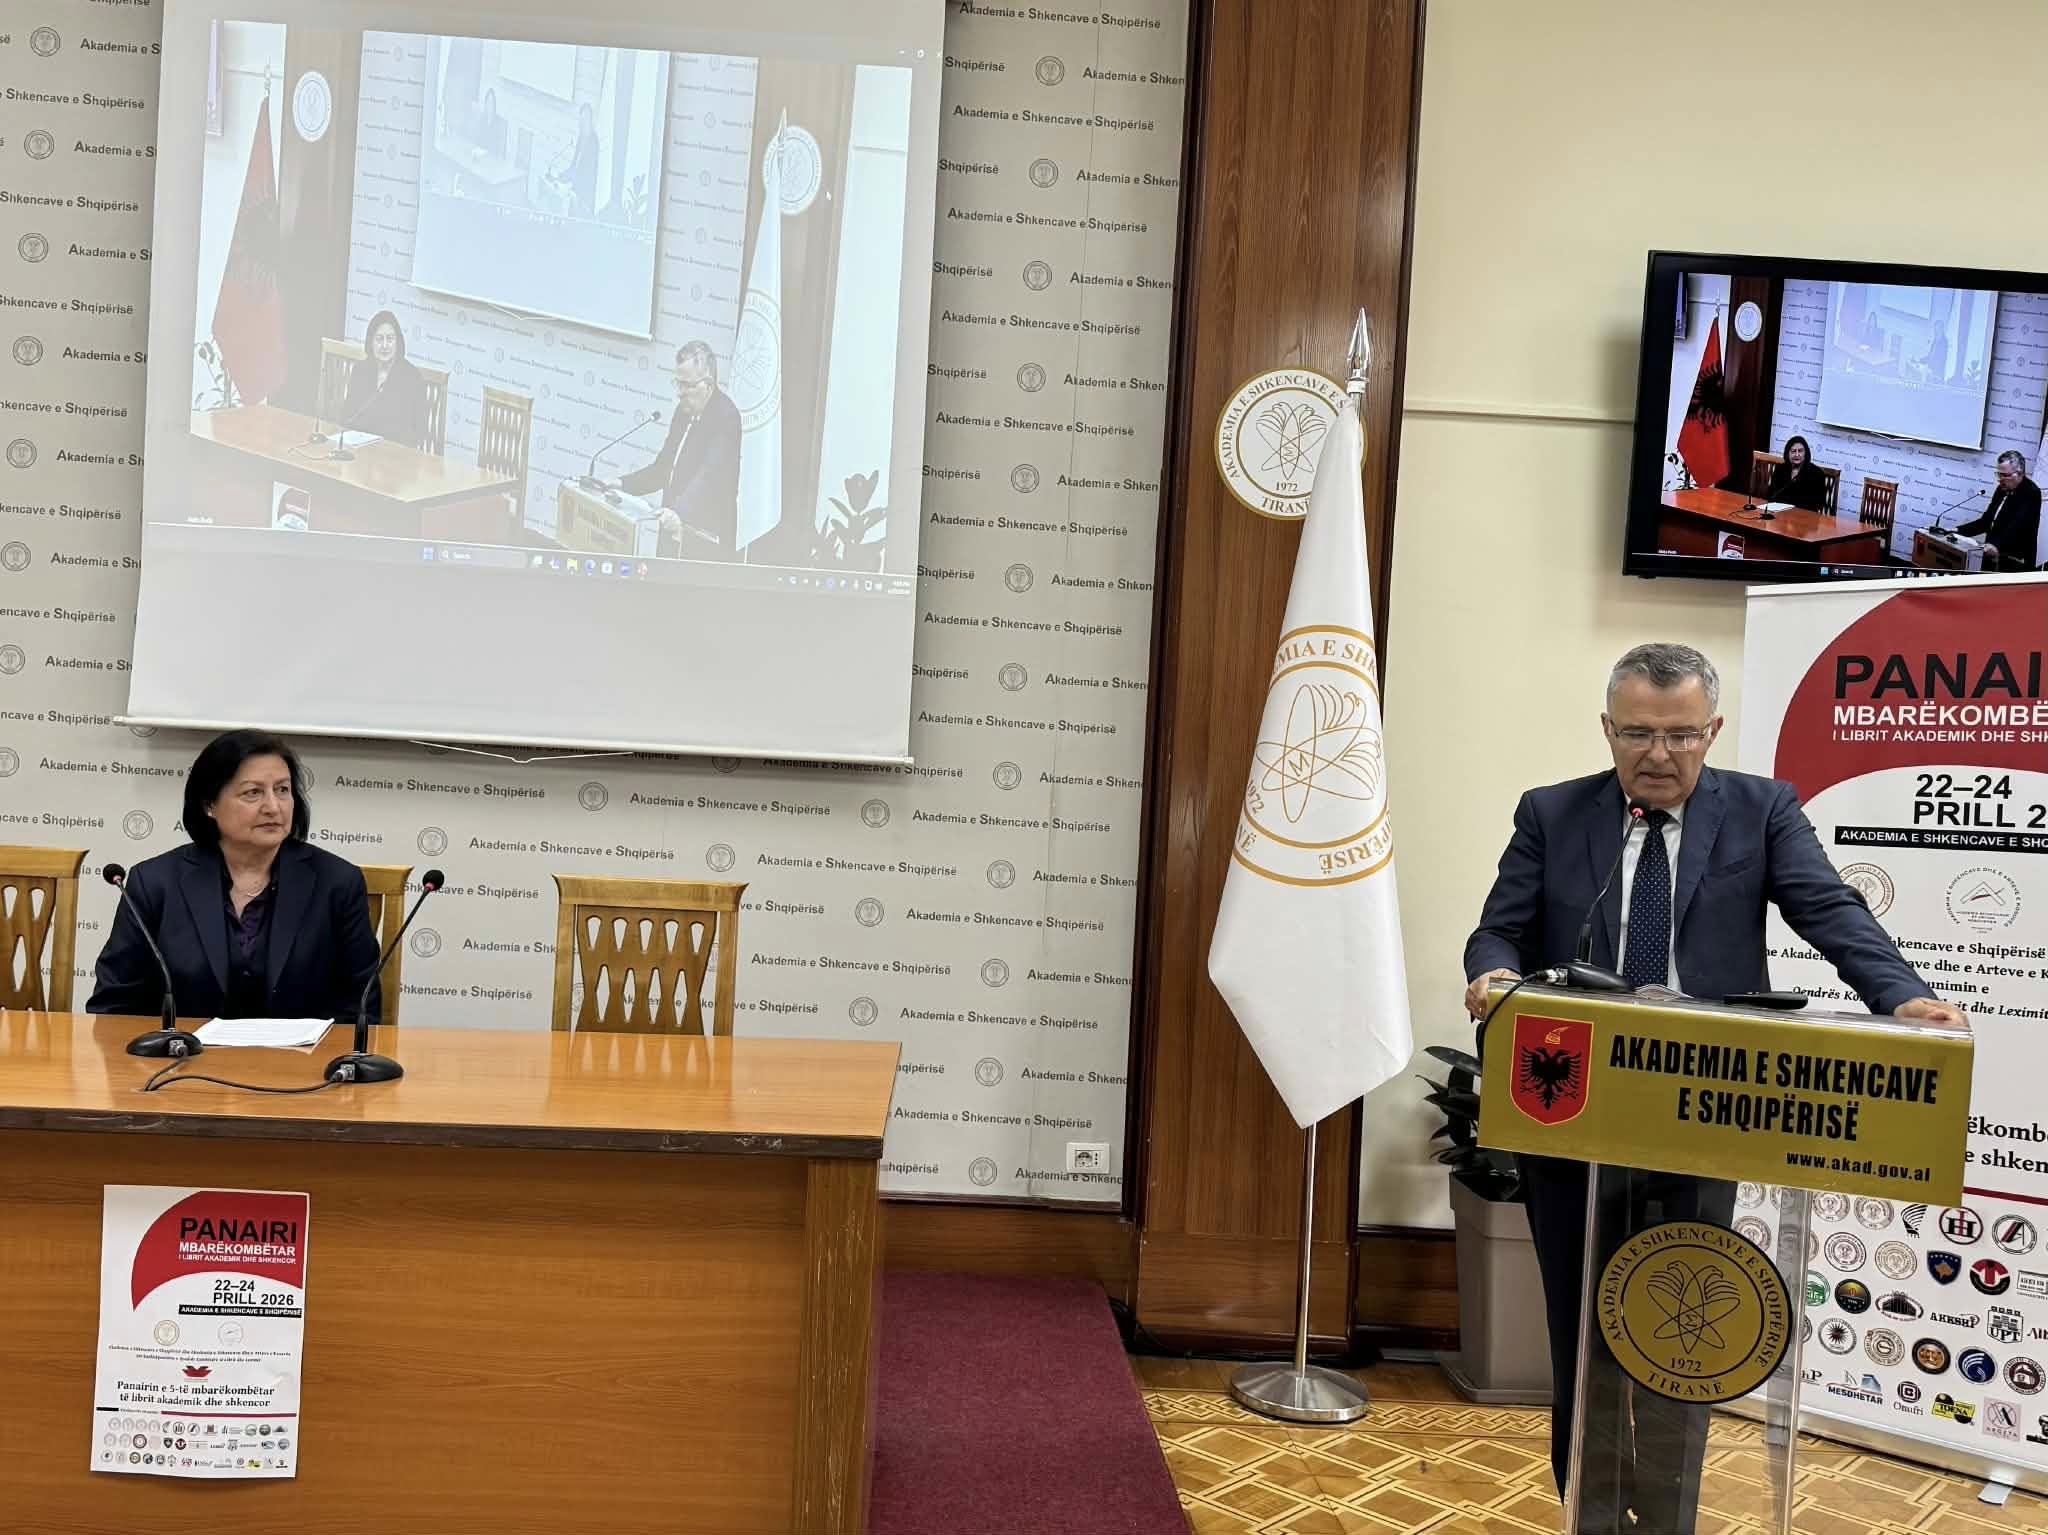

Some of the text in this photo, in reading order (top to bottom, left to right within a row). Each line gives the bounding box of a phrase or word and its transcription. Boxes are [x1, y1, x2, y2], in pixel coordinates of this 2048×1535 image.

[959, 1, 1016, 20] Akademia
[1028, 7, 1090, 24] Shkencave
[1100, 13, 1161, 29] Shqipërisë
[79, 37, 138, 54] Akademia
[945, 56, 1005, 74] Shqipërisë
[1082, 66, 1137, 82] Akademia
[1149, 71, 1185, 86] Shken
[5, 87, 70, 104] Shkencave
[82, 93, 145, 109] Shqipërisë
[952, 104, 1010, 120] Akademia
[1021, 109, 1083, 126] Shkencave
[1094, 115, 1154, 132] Shqipërisë
[73, 140, 133, 157] Akademia
[76, 195, 139, 212] Shqipërisë
[947, 207, 1003, 223] Akademia
[1015, 212, 1077, 228] Shkencave
[1087, 216, 1148, 233] Shqipërisë
[70, 299, 134, 315] Shqipërisë
[62, 346, 121, 362] Akademia
[1248, 375, 1327, 399] SHKENCAVE
[1275, 481, 1298, 492] 1972
[50, 551, 109, 567] Akademia
[923, 611, 979, 627] Akademia
[991, 616, 1052, 633] Shkencave
[1063, 620, 1123, 636] Shqipërisë
[1841, 729, 1889, 741] LIBRIT
[1892, 730, 1977, 742] AKADEMIK
[1981, 730, 2015, 743] DHE
[39, 757, 98, 773] Akademia
[110, 761, 175, 777] Shkencave
[335, 775, 394, 790] Akademia
[406, 779, 471, 795] Shkencave
[483, 783, 545, 799] Shqipërisë
[629, 792, 685, 807] Akademia
[697, 796, 759, 812] Shkencave
[770, 800, 831, 816] Shqipërisë
[1913, 800, 2016, 828] PRILL
[468, 836, 527, 852] Akademia
[539, 840, 603, 856] Shkencave
[615, 845, 675, 861] Shqipërisë
[1840, 830, 1908, 842] AKADEMIA
[1911, 833, 1919, 843] E
[1923, 833, 2006, 847] SHKENCAVE
[2009, 837, 2018, 847] E
[756, 853, 813, 868] Akademia
[824, 856, 886, 872] Shkencave
[898, 861, 957, 877] Shqipërisë
[905, 907, 961, 923] Akademia
[973, 911, 1034, 927] Shkencave
[1045, 916, 1105, 932] Shqipërisë
[1957, 943, 1965, 953] e
[1969, 943, 2046, 959] Shqipërisë
[1934, 959, 1960, 972] dhe
[1964, 964, 1972, 973] e
[1976, 964, 2024, 978] Arteve
[1981, 985, 1989, 994] e
[1970, 1001, 1994, 1015] dhe
[899, 1007, 955, 1022] Akademia
[967, 1010, 1028, 1026] Shkencave
[1039, 1015, 1099, 1030] Shqipërisë
[1610, 1035, 1939, 1104] AKADEMIA E SHKENCAVE
[1677, 1088, 1859, 1142] E SHQIPËRISË
[1967, 1115, 2048, 1143] ëkomb
[1786, 1151, 1931, 1182] www.akad.gov.al
[180, 1217, 297, 1244] PANAIRI
[179, 1241, 296, 1257] MBARËKOMBËTAR
[1603, 1257, 1634, 1342] AKADEMIA
[1641, 1227, 1748, 1258] SHKENCAVE
[213, 1292, 294, 1306] PRILL 2026
[1670, 1357, 1702, 1372] 1972
[117, 1380, 159, 1392] Panairin
[169, 1384, 189, 1394] 5-të
[191, 1385, 275, 1396] mbarëkombëtar
[1647, 1371, 1726, 1396] TIRANË
[156, 1394, 202, 1406] akademik
[204, 1396, 223, 1407] dhe
[225, 1397, 271, 1408] shkencor
